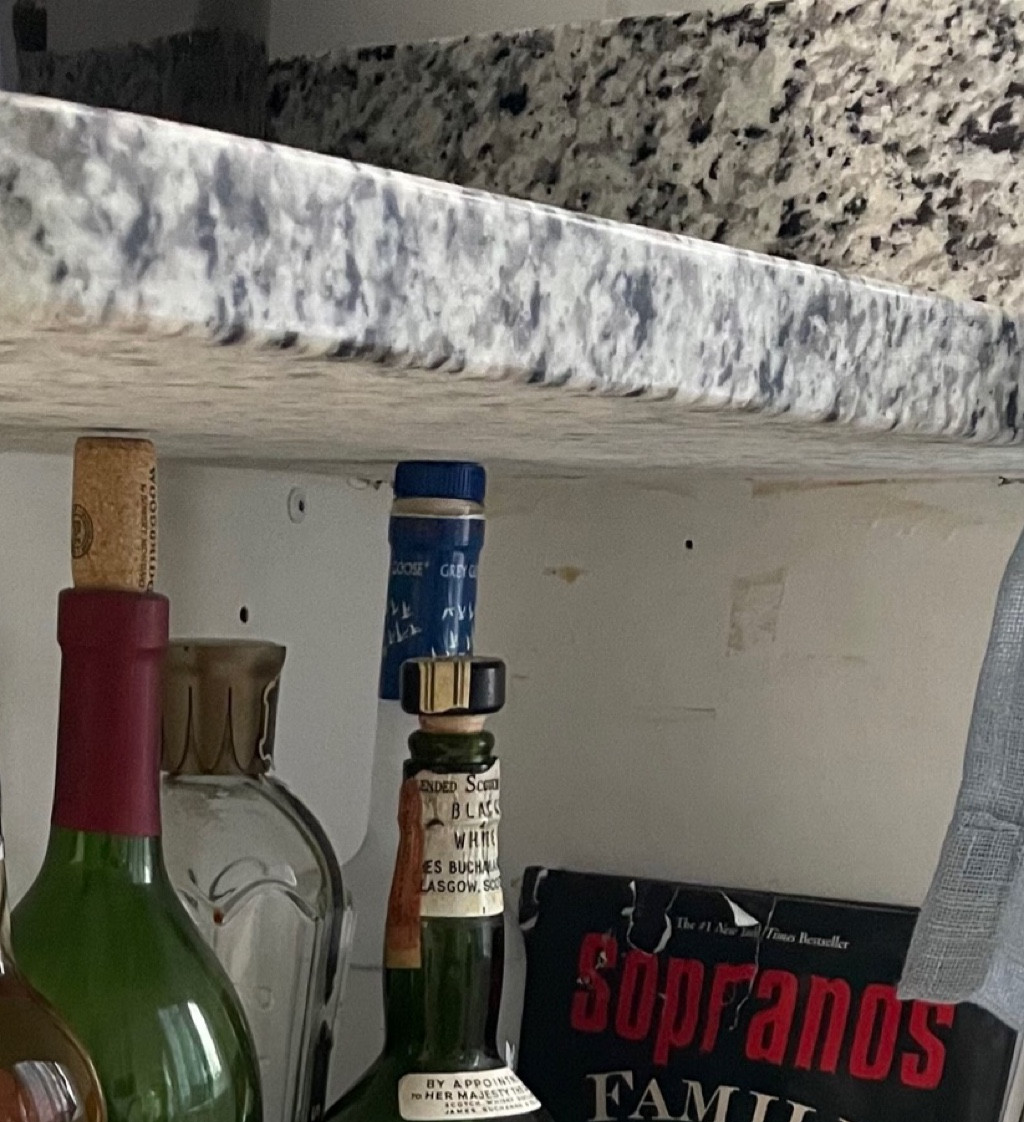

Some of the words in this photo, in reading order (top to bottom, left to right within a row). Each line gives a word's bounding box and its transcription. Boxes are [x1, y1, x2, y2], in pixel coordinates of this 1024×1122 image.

[677, 916, 696, 931] The
[426, 1079, 445, 1089] BY
[425, 1090, 453, 1101] HER
